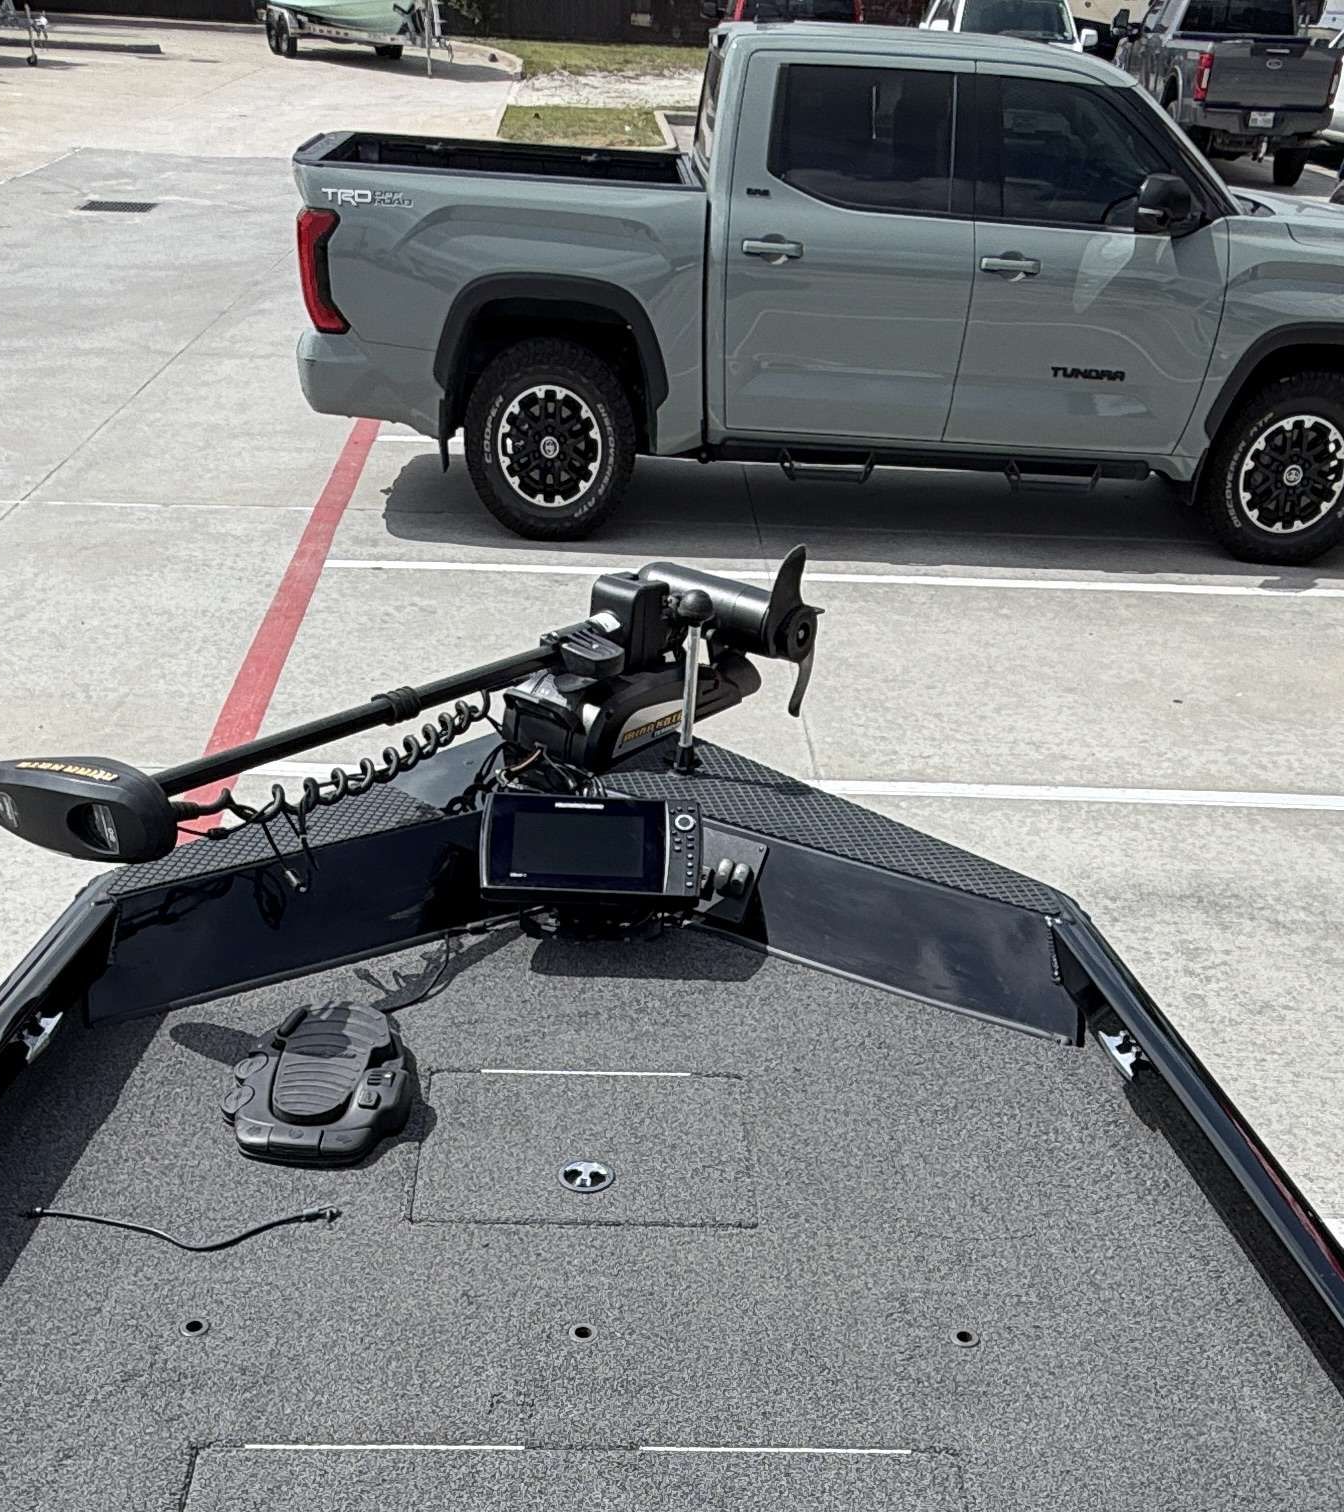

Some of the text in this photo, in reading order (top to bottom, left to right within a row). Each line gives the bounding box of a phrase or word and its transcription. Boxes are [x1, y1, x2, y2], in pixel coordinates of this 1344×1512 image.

[321, 187, 372, 206] TRD
[1051, 366, 1125, 382] TUNDRA
[483, 395, 504, 464] COOPER
